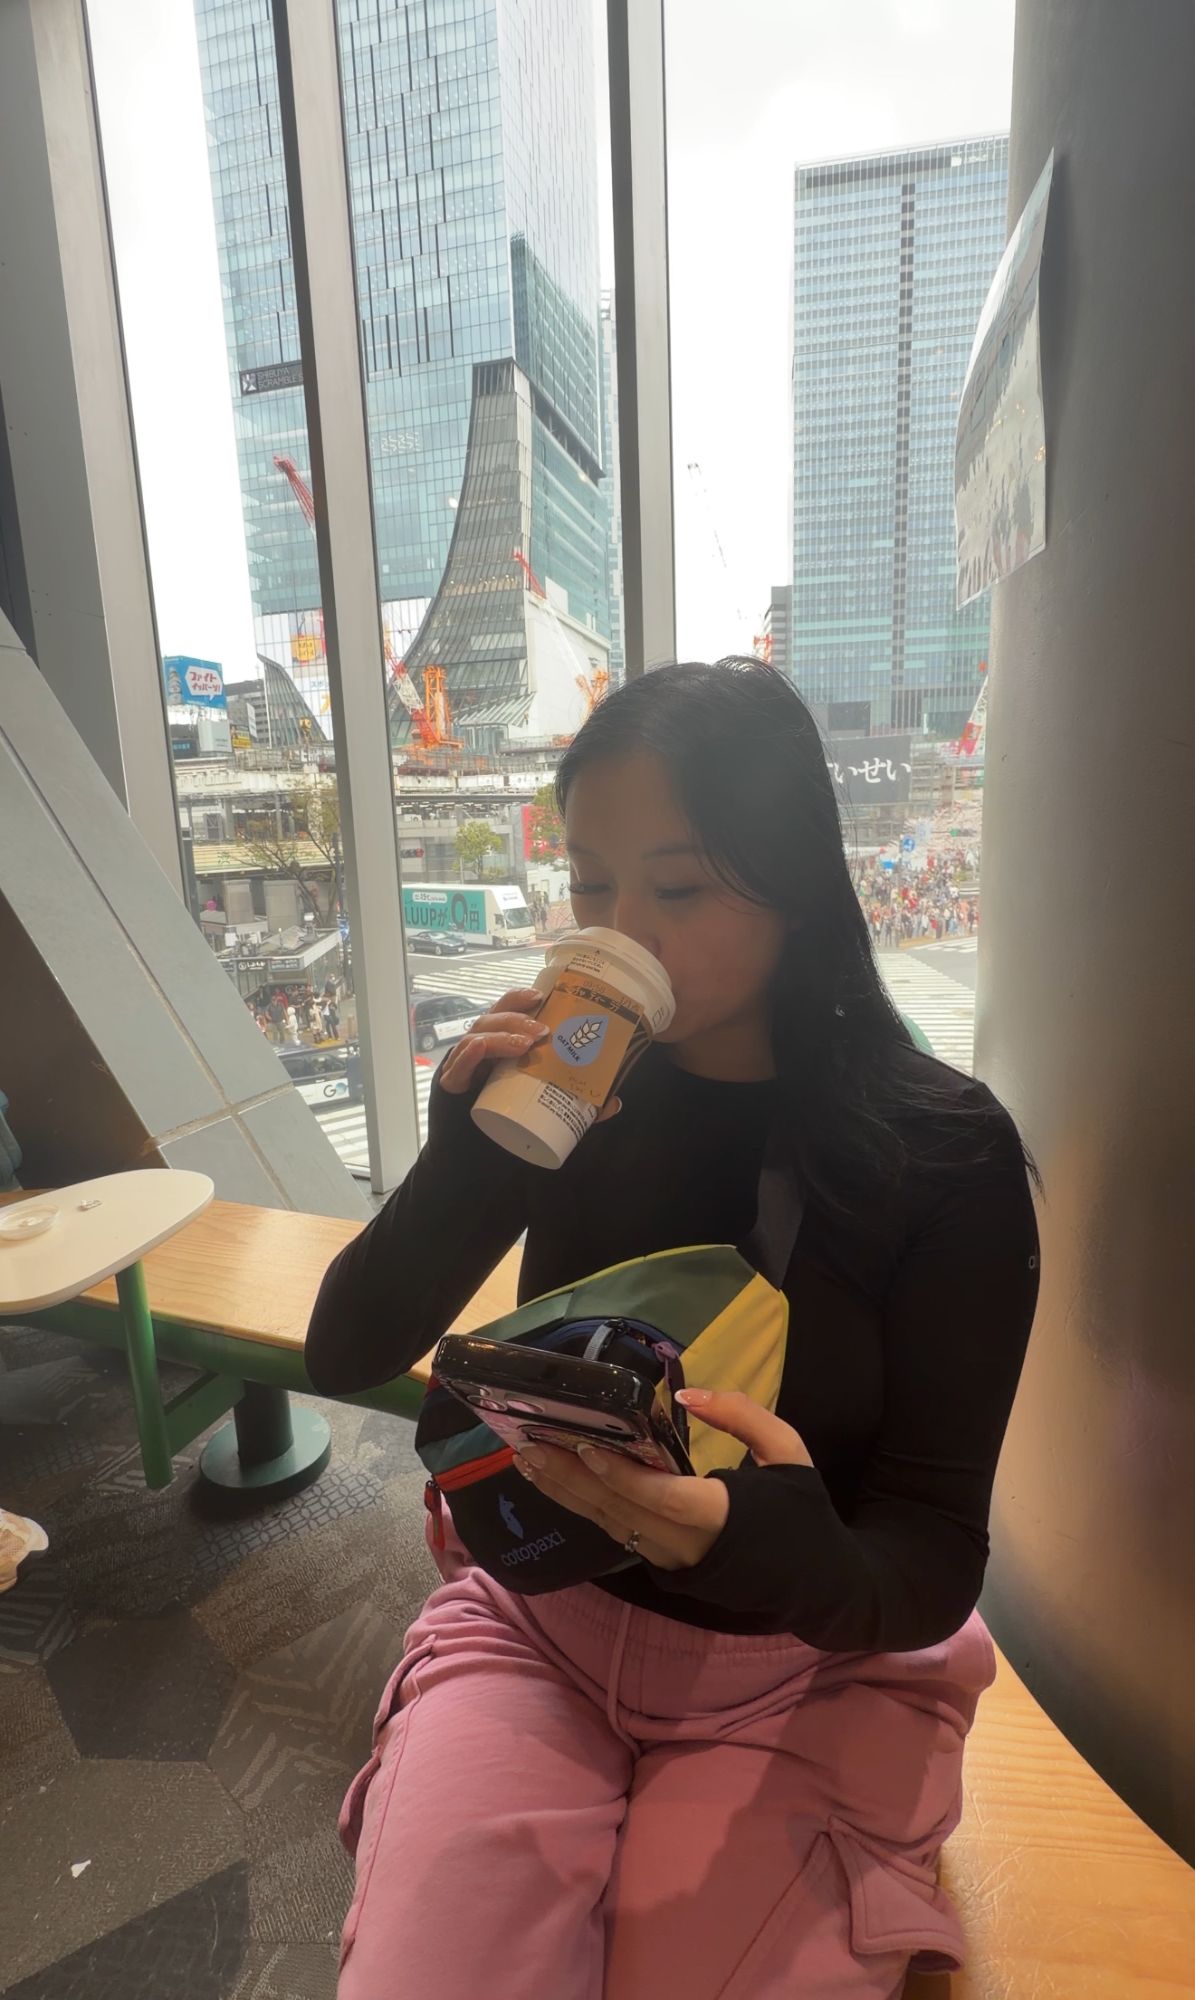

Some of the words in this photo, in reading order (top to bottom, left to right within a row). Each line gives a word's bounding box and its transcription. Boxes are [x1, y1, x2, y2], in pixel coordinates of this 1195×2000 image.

[827, 757, 912, 784] いせい
[557, 1035, 569, 1047] OAT
[568, 1046, 580, 1062] MILK
[501, 1528, 566, 1567] cotopaxi
